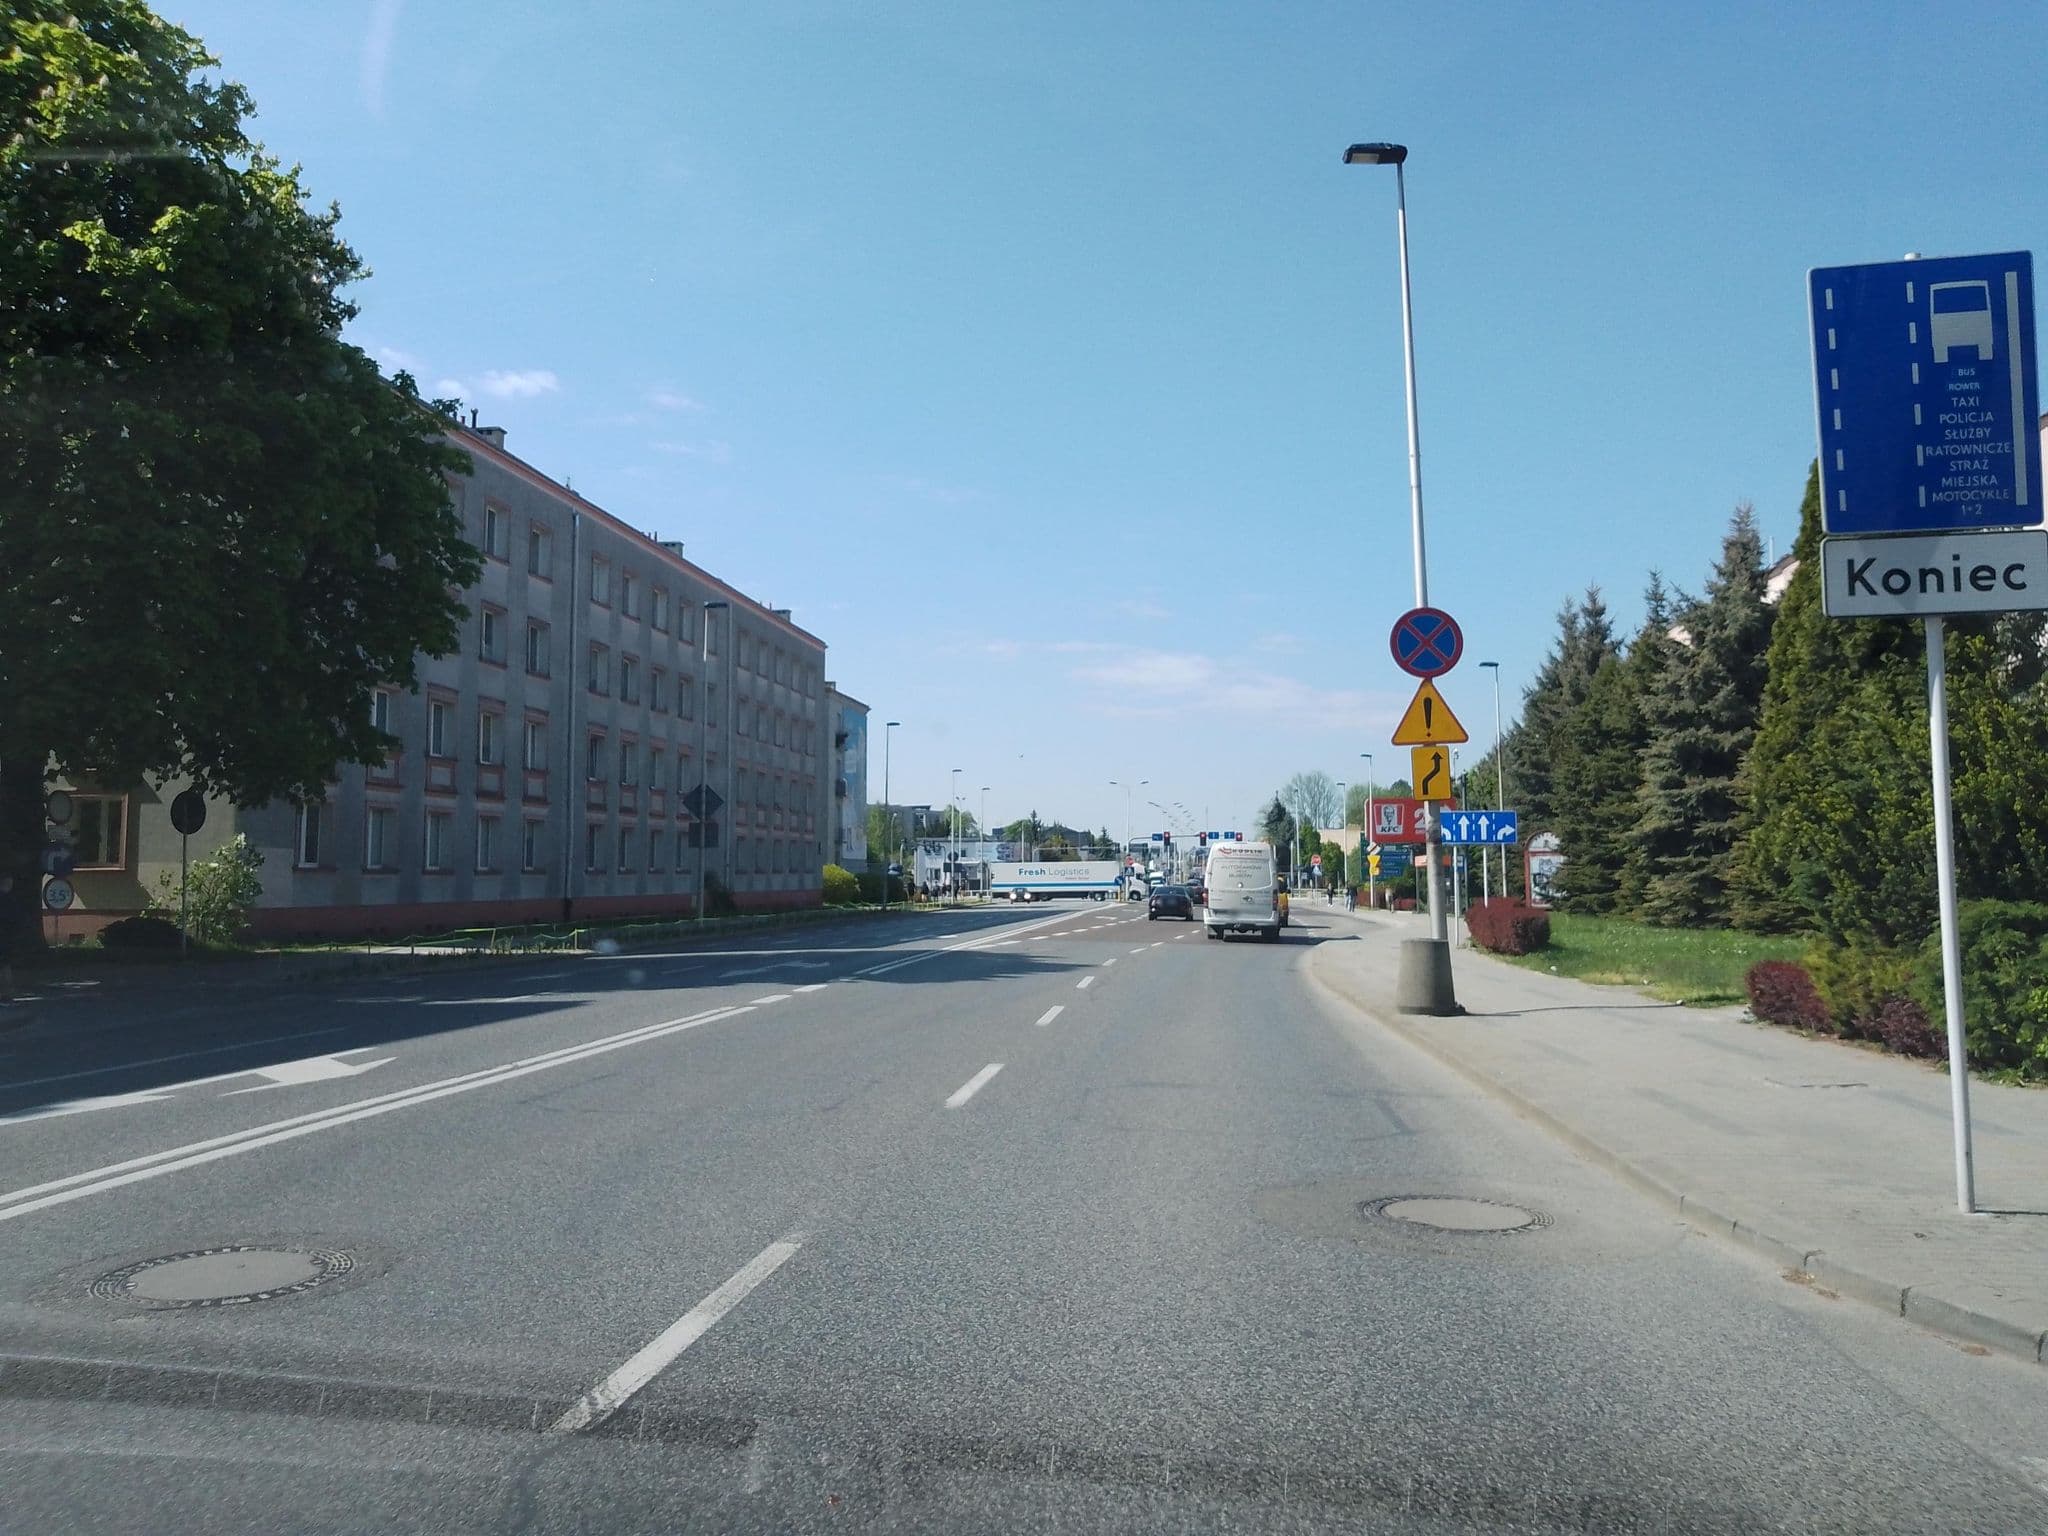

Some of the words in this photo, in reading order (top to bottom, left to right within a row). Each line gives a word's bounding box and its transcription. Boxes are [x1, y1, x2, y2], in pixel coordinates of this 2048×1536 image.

[1958, 368, 1976, 376] BUS
[1949, 382, 1980, 391] ROWER
[1951, 396, 1980, 407] TAXI
[1939, 411, 1995, 424] POLICJA
[1926, 442, 2012, 456] RATOWNICZE
[1941, 475, 1998, 487] MIEJSKA
[1932, 489, 2010, 503] MOTOCYKLE
[1846, 554, 2028, 597] Koniec
[1380, 825, 1399, 833] KFC
[1018, 868, 1046, 876] Fresh
[1048, 868, 1090, 877] Logistics
